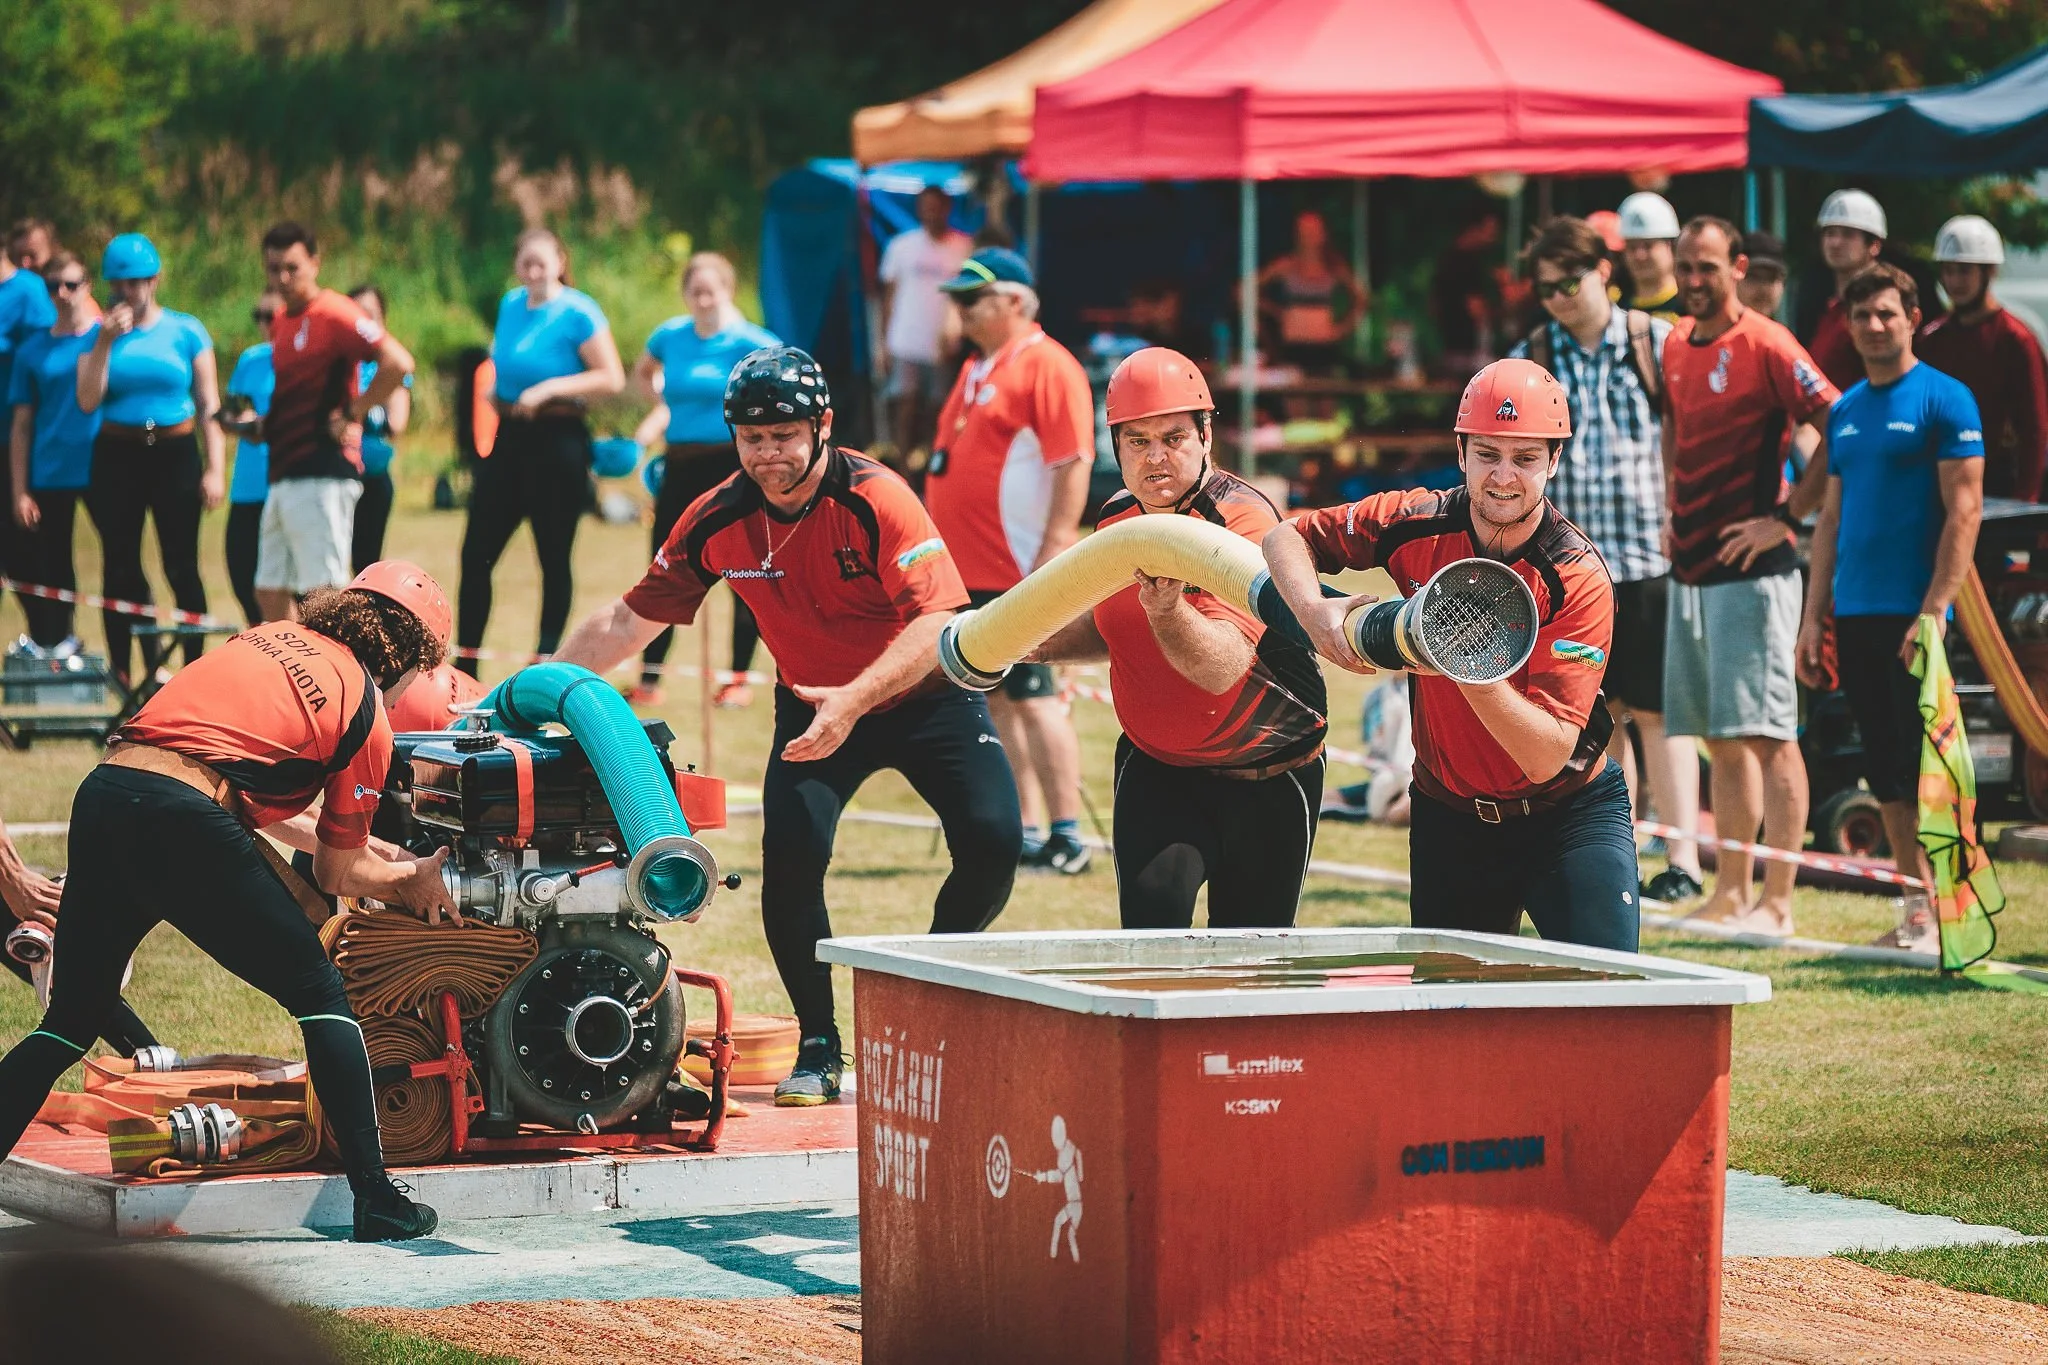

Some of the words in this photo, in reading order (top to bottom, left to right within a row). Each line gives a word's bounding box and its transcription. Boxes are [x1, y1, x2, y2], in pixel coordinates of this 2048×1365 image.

[1495, 413, 1519, 422] CAMP
[274, 632, 321, 657] SDH
[279, 656, 328, 714] LHOTA
[862, 1025, 946, 1124] POŽÁRNÍ
[1224, 1098, 1281, 1115] KOSKY
[874, 1123, 930, 1203] SPORT
